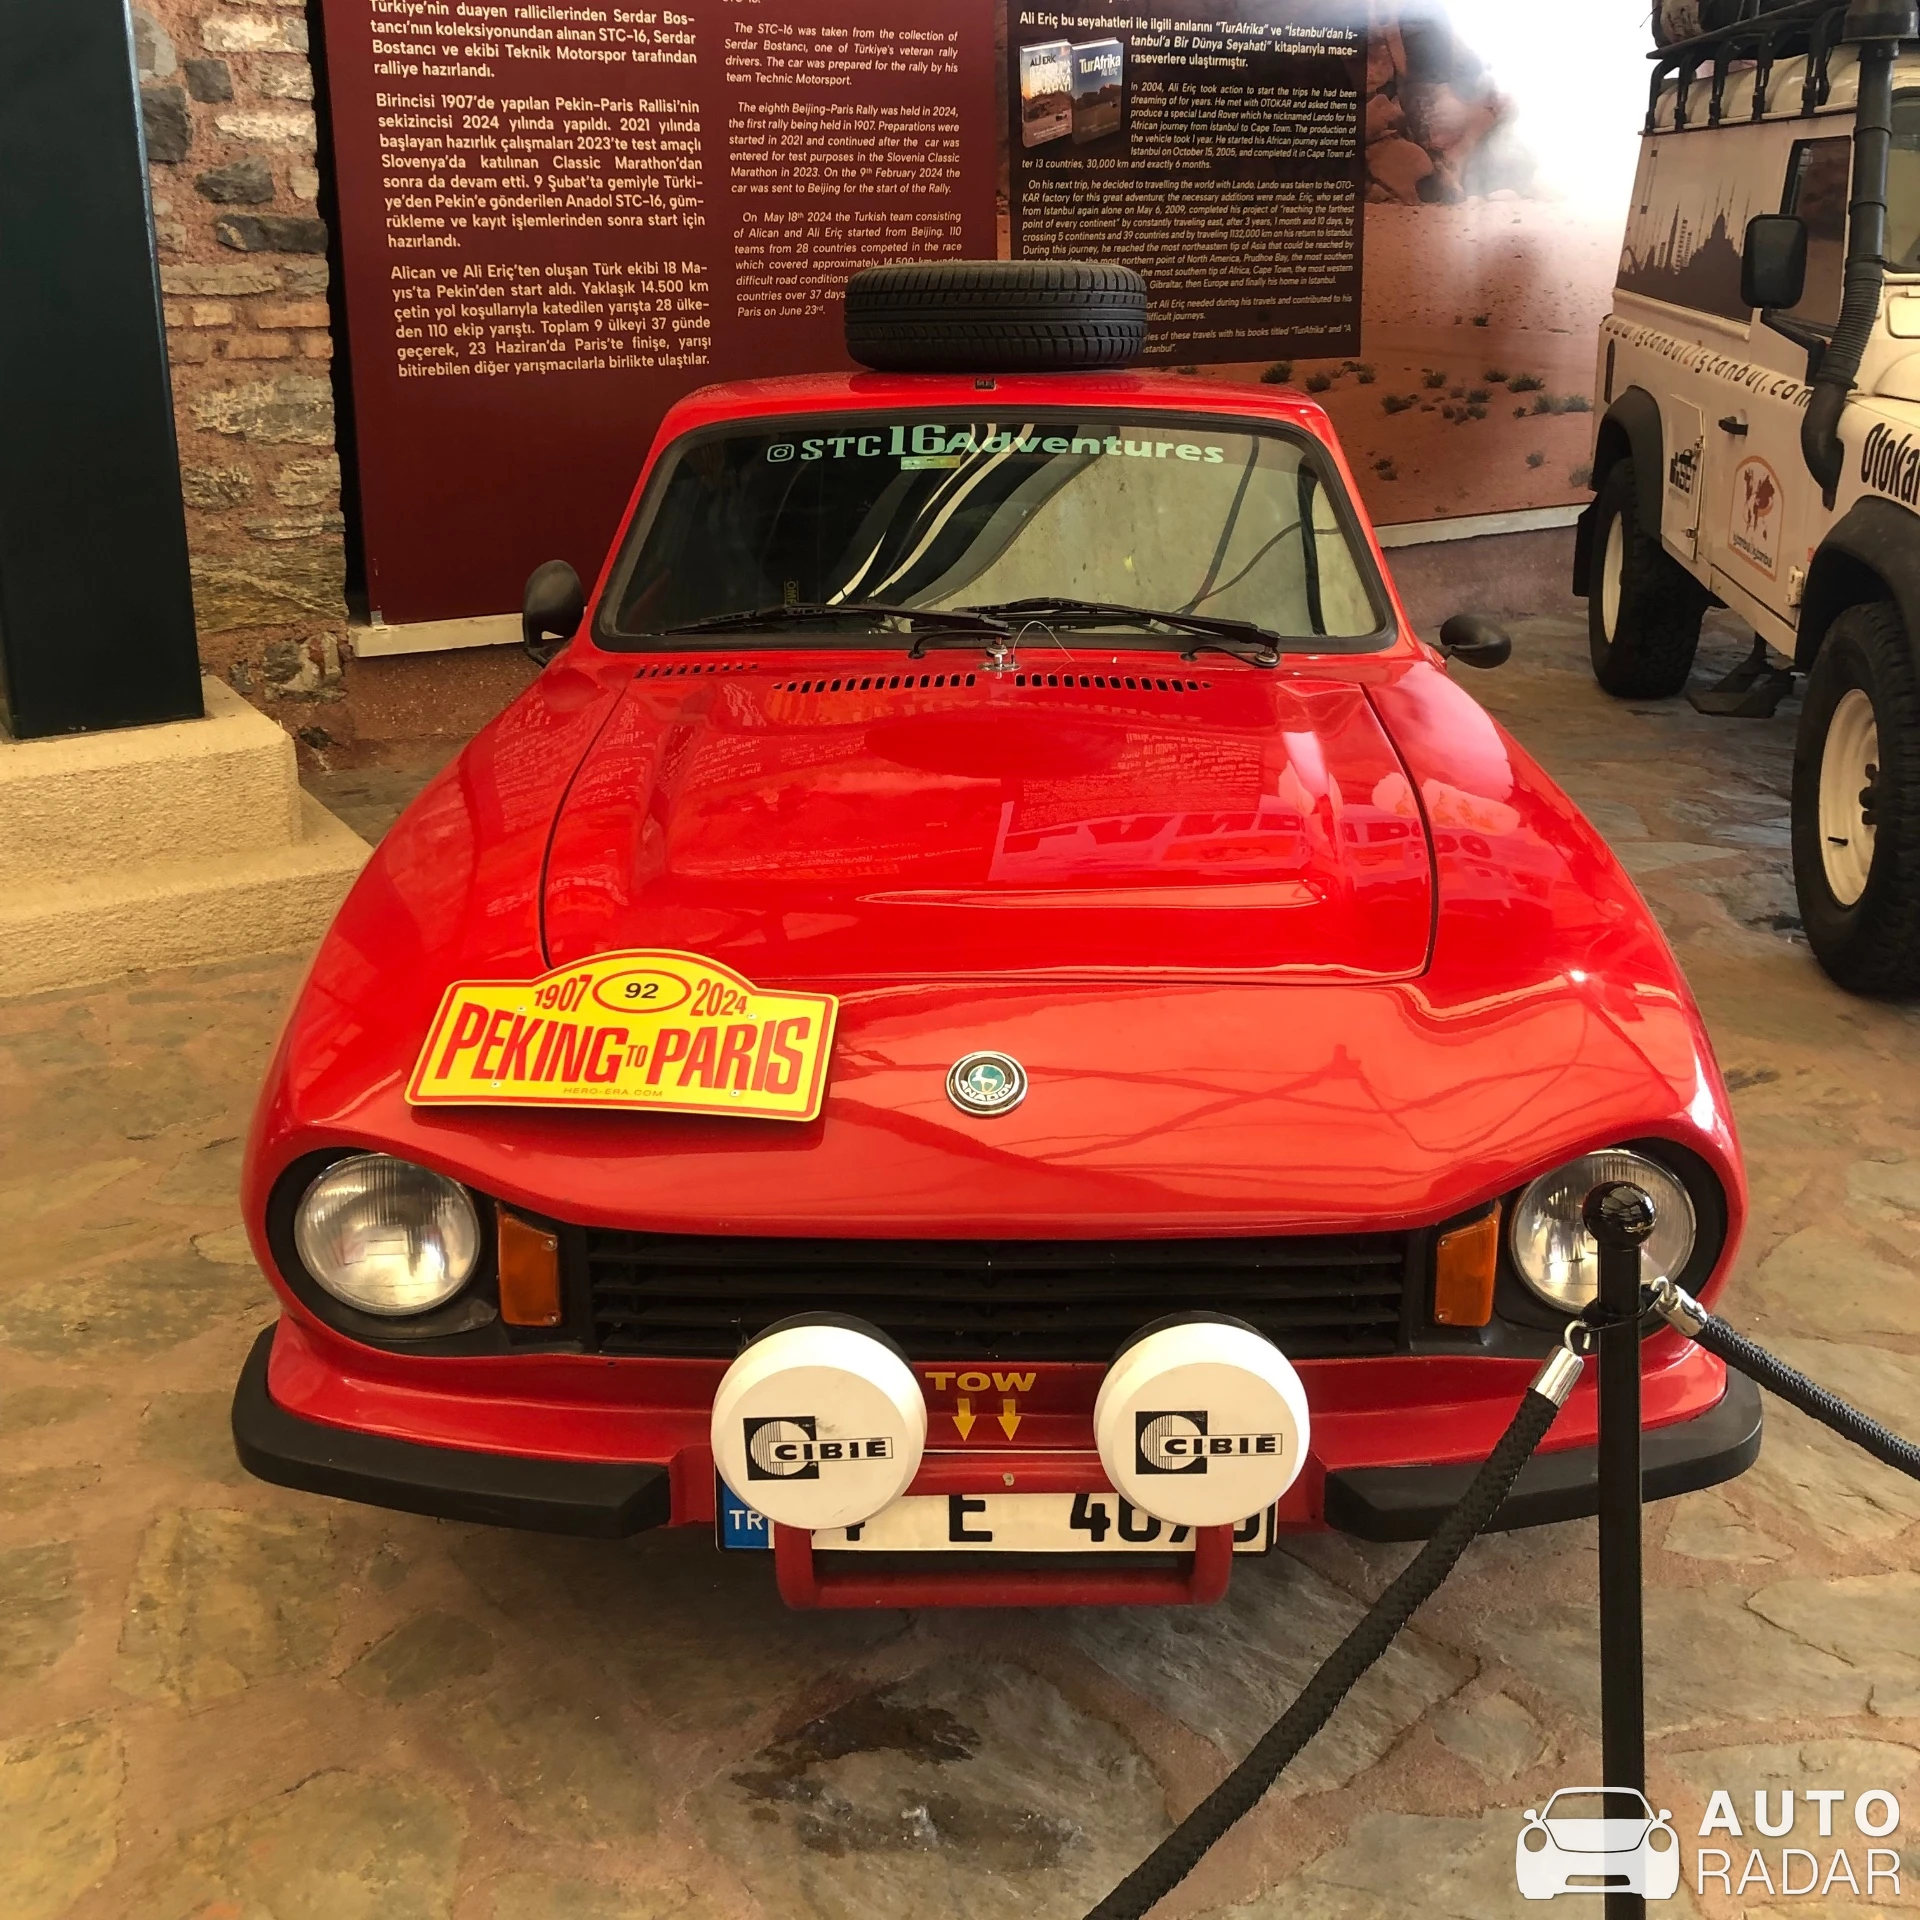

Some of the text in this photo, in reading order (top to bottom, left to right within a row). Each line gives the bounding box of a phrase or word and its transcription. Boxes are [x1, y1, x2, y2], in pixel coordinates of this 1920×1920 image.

[368, 0, 695, 25] Türkiye'nin duayen rallicilerinden Serdar Bos-
[369, 19, 696, 45] tancı'nın koleksiyonundan alınan STC-16, Serdar
[733, 21, 958, 41] The STC-16 was taken from the collection of
[1019, 11, 1034, 24] Ali
[1037, 12, 1058, 29] Eriç
[1061, 12, 1074, 26] bu
[1077, 14, 1133, 30] seyahatleri
[1135, 16, 1148, 29] ile
[1150, 17, 1171, 32] ilgili
[1173, 19, 1212, 32] anılarını
[1270, 26, 1282, 36] ve
[1344, 25, 1358, 39] İs-
[372, 40, 697, 64] Bostancı ve ekibi Teknik Motorspor tarafından
[724, 38, 958, 59] Serdar Bostancı, one of Türkiye's veteran rally
[1130, 34, 1358, 56] tanbul'a Bir Dünya Seyahati" kitaplarıyla mace-
[374, 61, 495, 78] ralliye hazırlandı.
[1130, 52, 1248, 69] raseverlere ulaştırmıştır.
[1130, 81, 1357, 98] In 2004, Ali Eriç took action to start the trips he had been
[376, 93, 699, 113] Birincisi 1907'de yapılan Pekin-Paris Rallisi'nin
[378, 114, 700, 134] sekizincisi 2024 yılında yapıldı. 2021 yılında
[379, 134, 701, 153] başlayan hazırlık çalışmaları 2023'te test amaçlı
[381, 154, 702, 171] Slovenya'da katılınan Classic Marathon'dan
[729, 150, 960, 163] entered for test purposes in the Slovenia Classic
[1021, 158, 1211, 170] ter 13 countries, 30,000 km and exactly 6 months.
[730, 166, 777, 177] Marathon
[780, 166, 789, 177] in
[792, 166, 820, 177] 2023.
[823, 166, 838, 177] On
[841, 166, 856, 177] the
[875, 167, 916, 180] February
[919, 167, 942, 177] 2024
[946, 167, 960, 177] the
[734, 241, 962, 254] teams from 28 countries competed in the race
[736, 288, 845, 301] countries over 37 days
[398, 352, 709, 377] bitirebilen diğer yarışmacılarla birlikte ulaştılar.
[534, 974, 748, 1016] 1907 92 2024
[435, 1002, 811, 1094] PEKING TO PARIS
[564, 1087, 663, 1097] HERO-ERA.COM
[961, 1080, 1013, 1101] ANADOL
[925, 1372, 1036, 1392] TOW
[729, 1510, 764, 1530] TR
